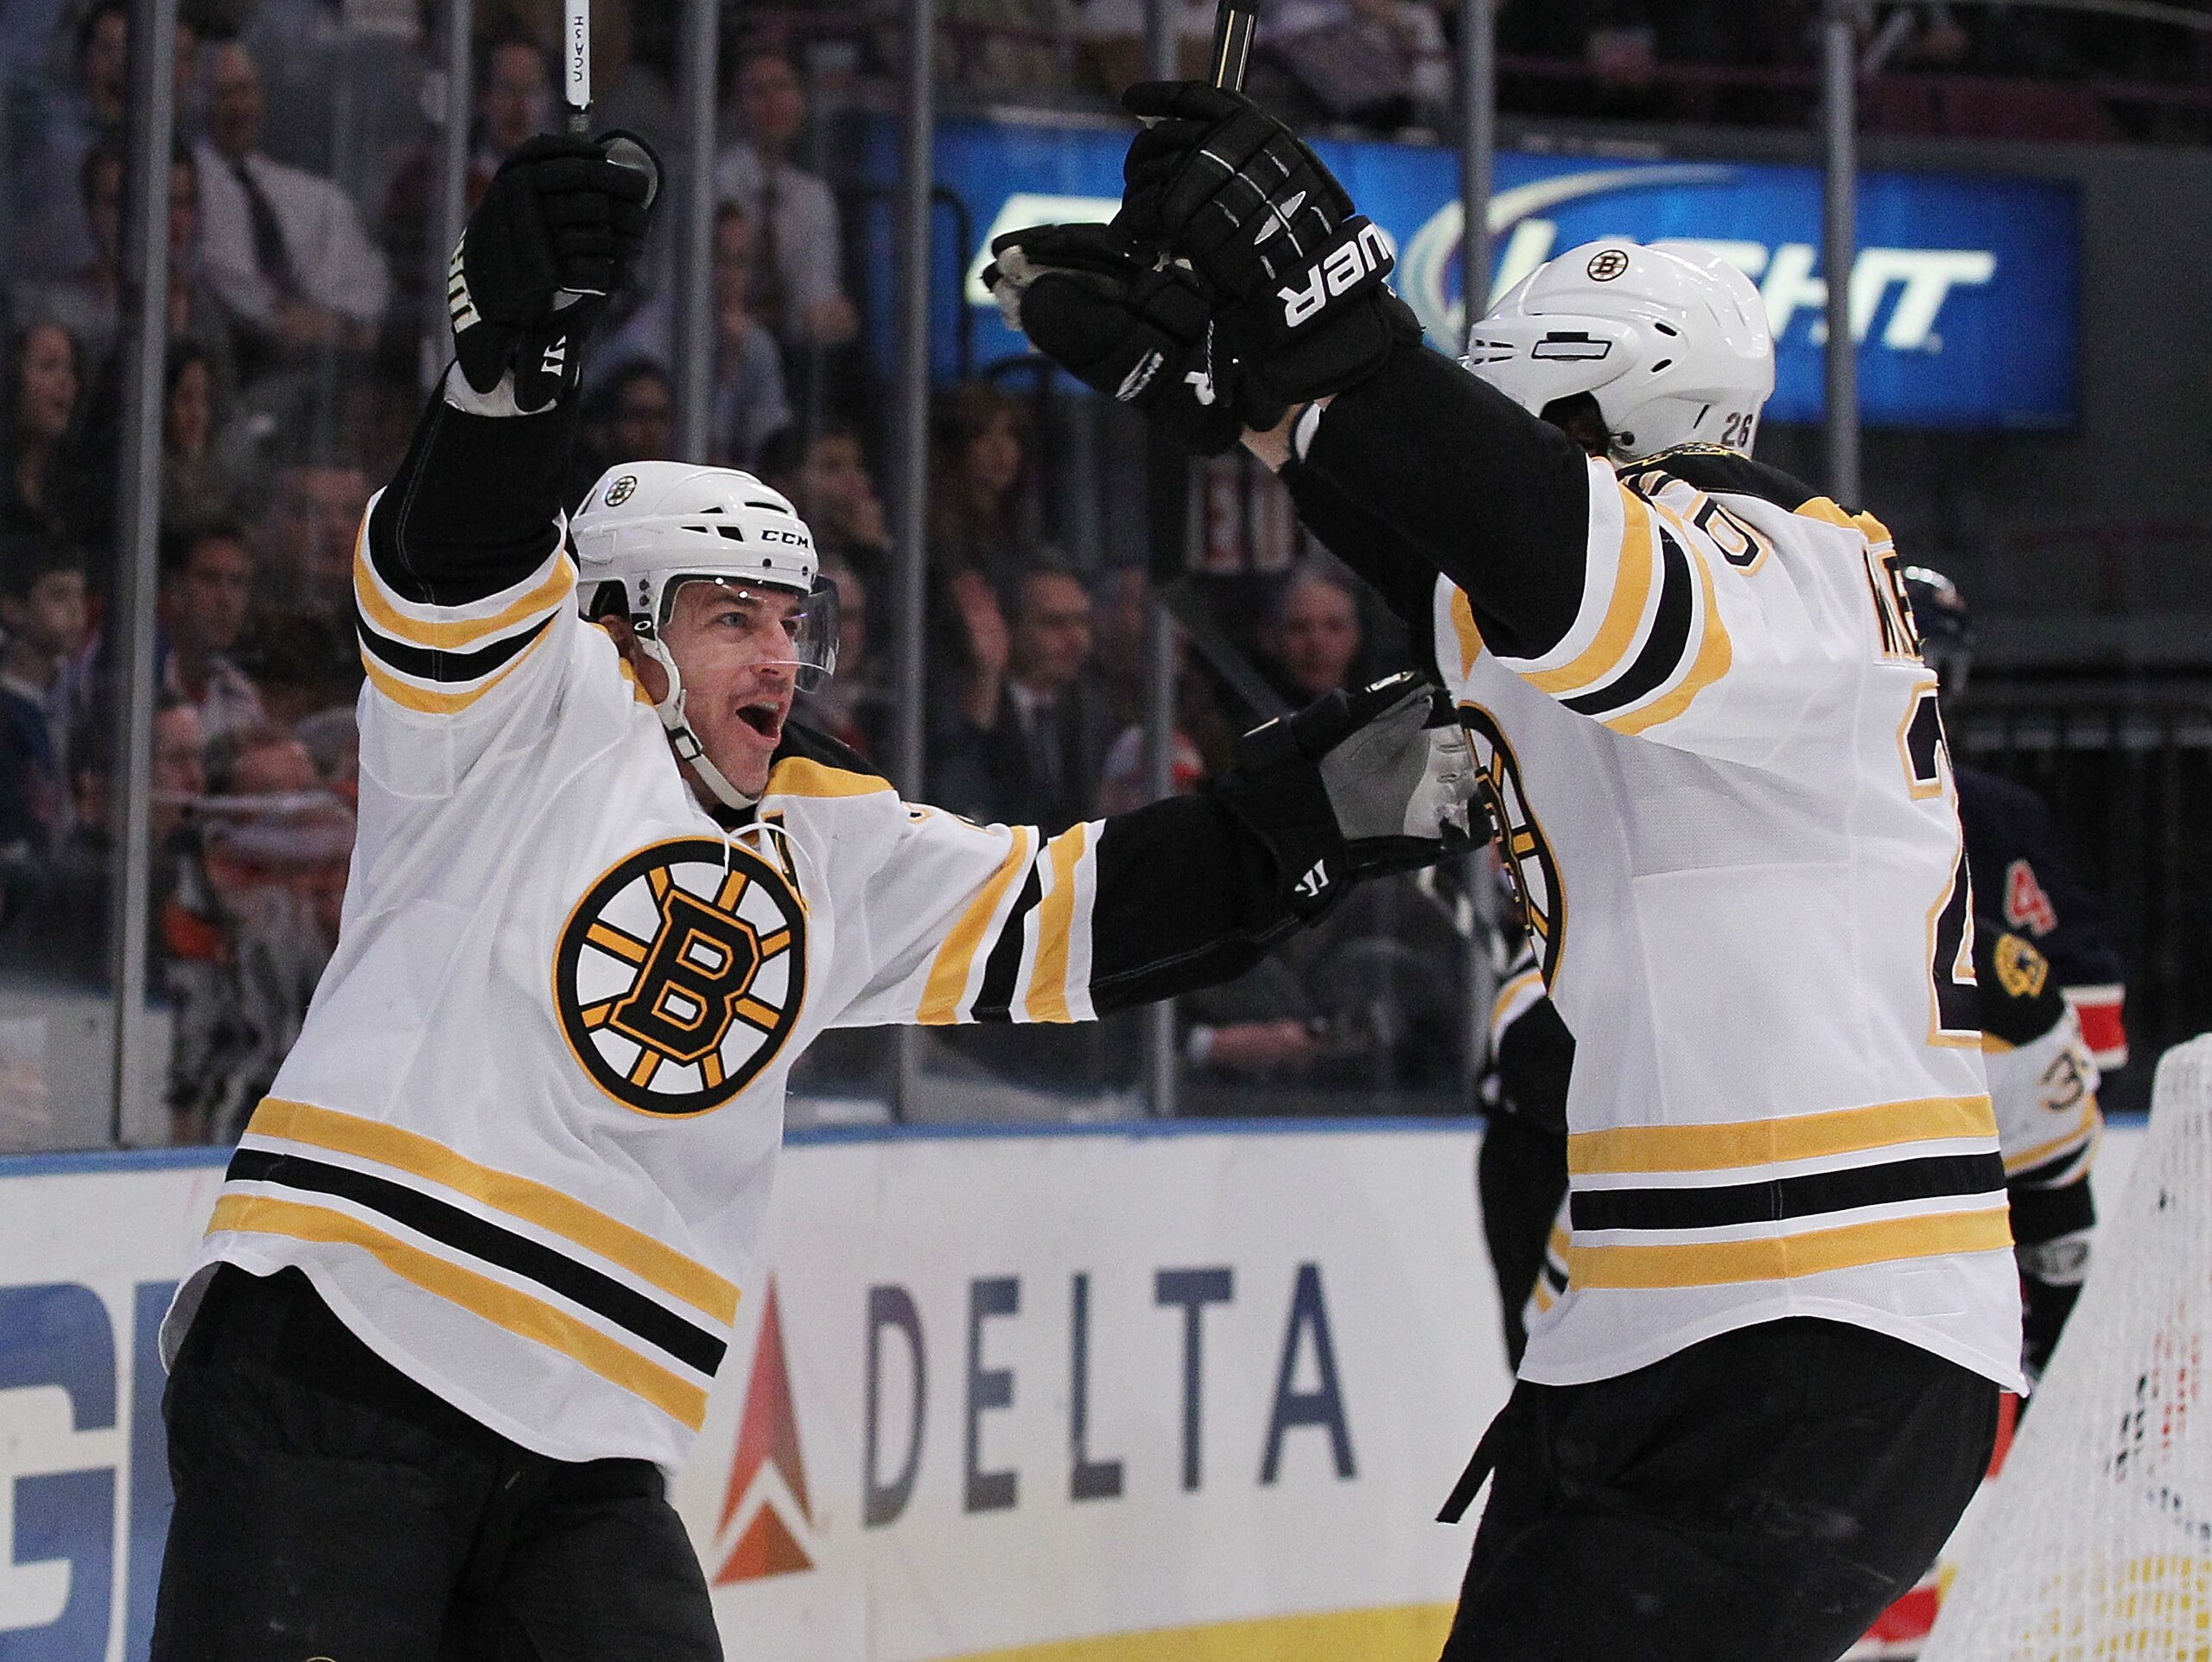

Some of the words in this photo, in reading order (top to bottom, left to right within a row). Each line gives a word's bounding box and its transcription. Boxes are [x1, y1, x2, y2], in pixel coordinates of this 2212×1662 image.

[1593, 255, 1619, 274] B
[761, 529, 810, 549] CCM
[2004, 859, 2058, 936] 4
[605, 887, 766, 1067] B
[2039, 1048, 2089, 1115] 3
[862, 1262, 1358, 1530] DELTA
